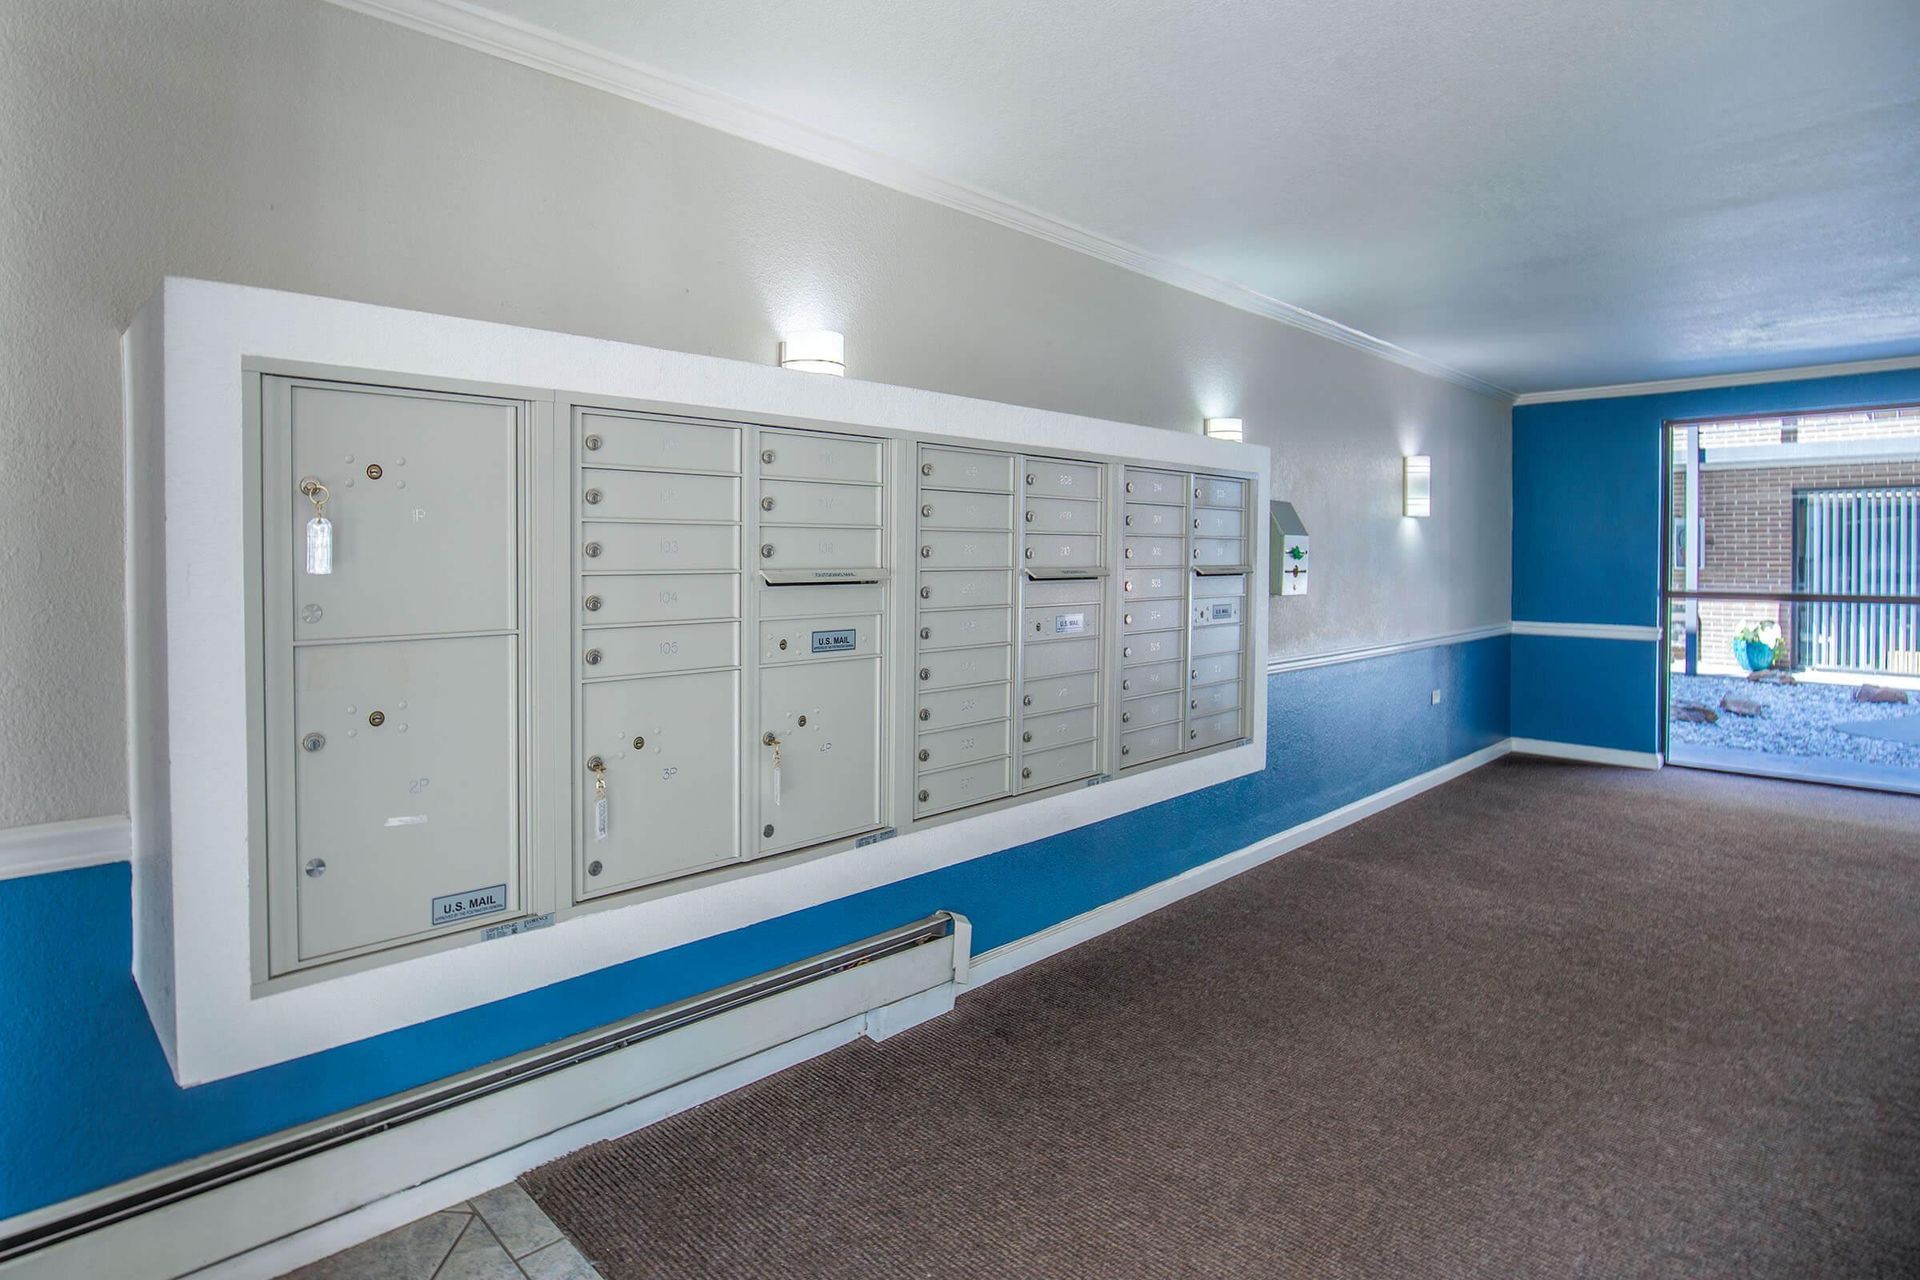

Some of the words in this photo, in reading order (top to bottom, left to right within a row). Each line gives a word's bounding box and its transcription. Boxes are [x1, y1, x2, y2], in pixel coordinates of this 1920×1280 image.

[659, 591, 679, 604] 104
[818, 637, 832, 646] U.S.
[833, 636, 850, 644] MAIL
[658, 641, 679, 655] 105
[662, 767, 678, 780] 3P
[409, 778, 430, 794] 2P
[443, 902, 466, 914] U.S.
[469, 895, 497, 909] MAIL
